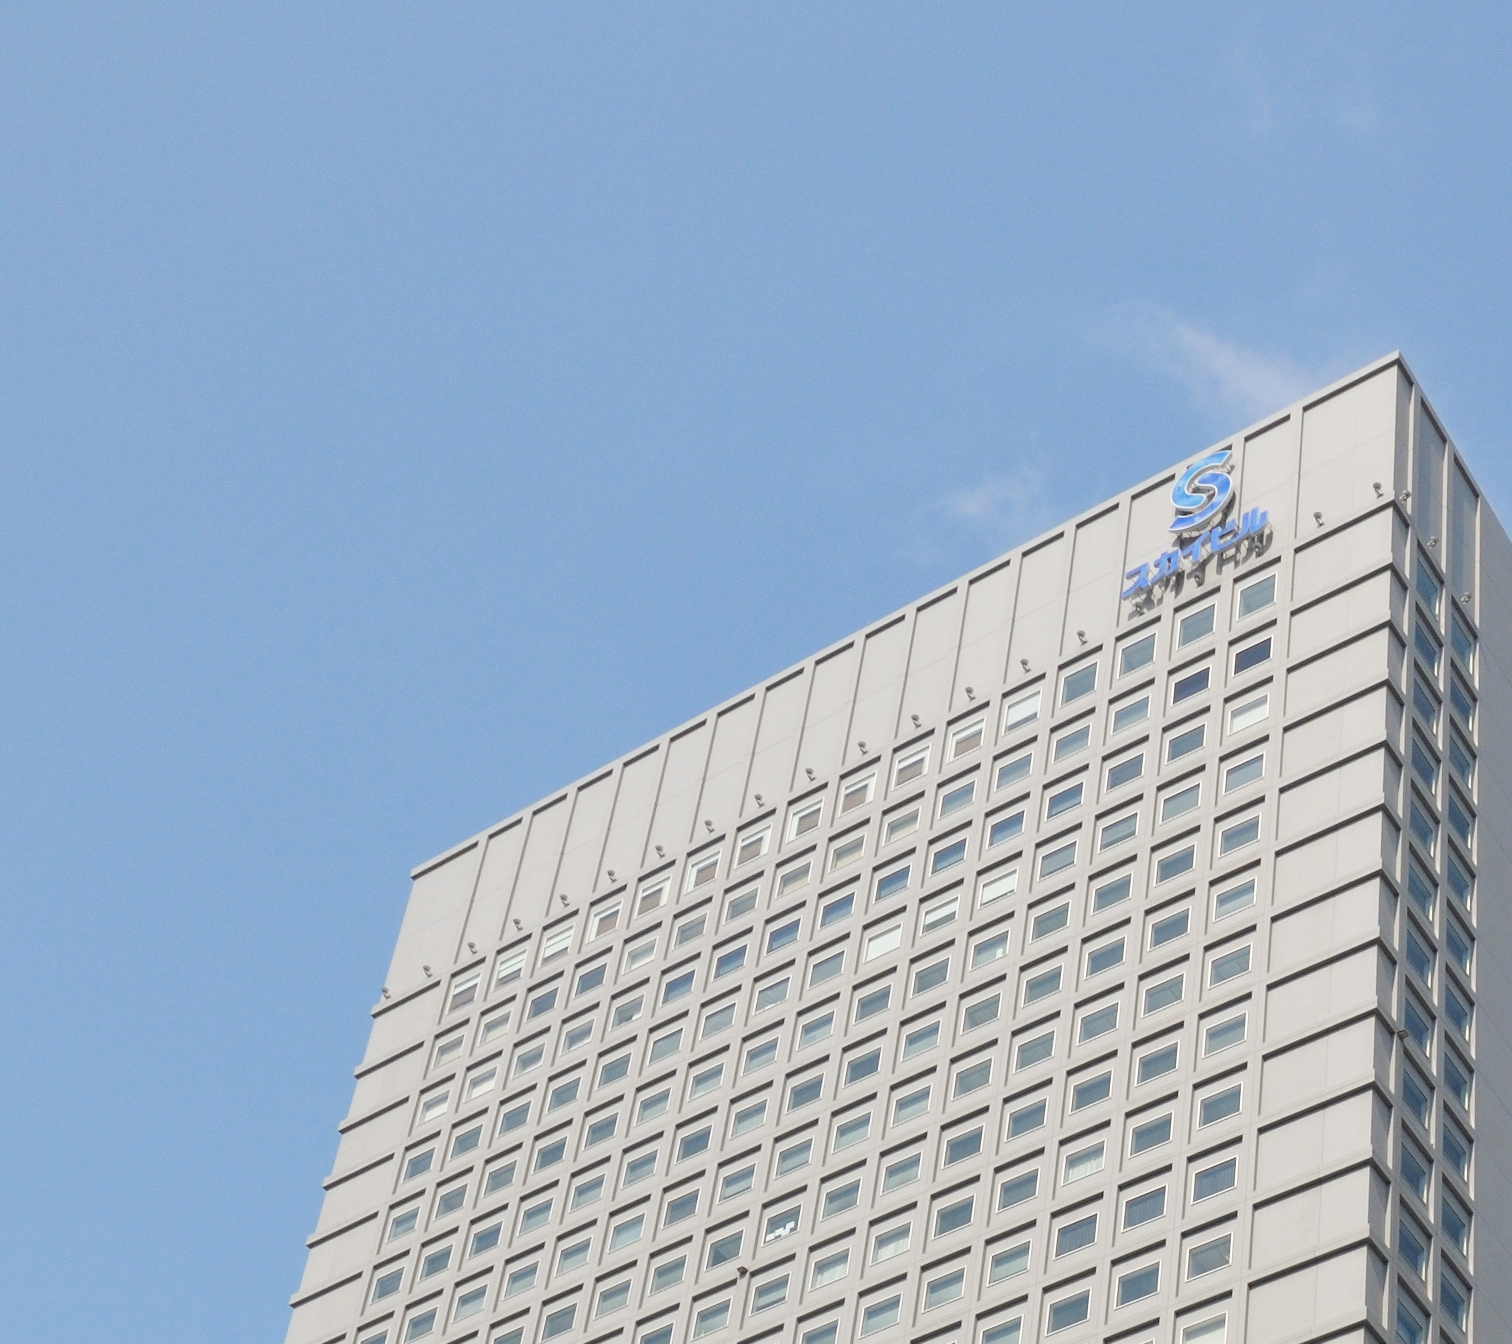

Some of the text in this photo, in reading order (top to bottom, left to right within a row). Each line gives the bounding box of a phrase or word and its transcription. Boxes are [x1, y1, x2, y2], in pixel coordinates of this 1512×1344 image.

[1121, 506, 1269, 601] スカイビル
